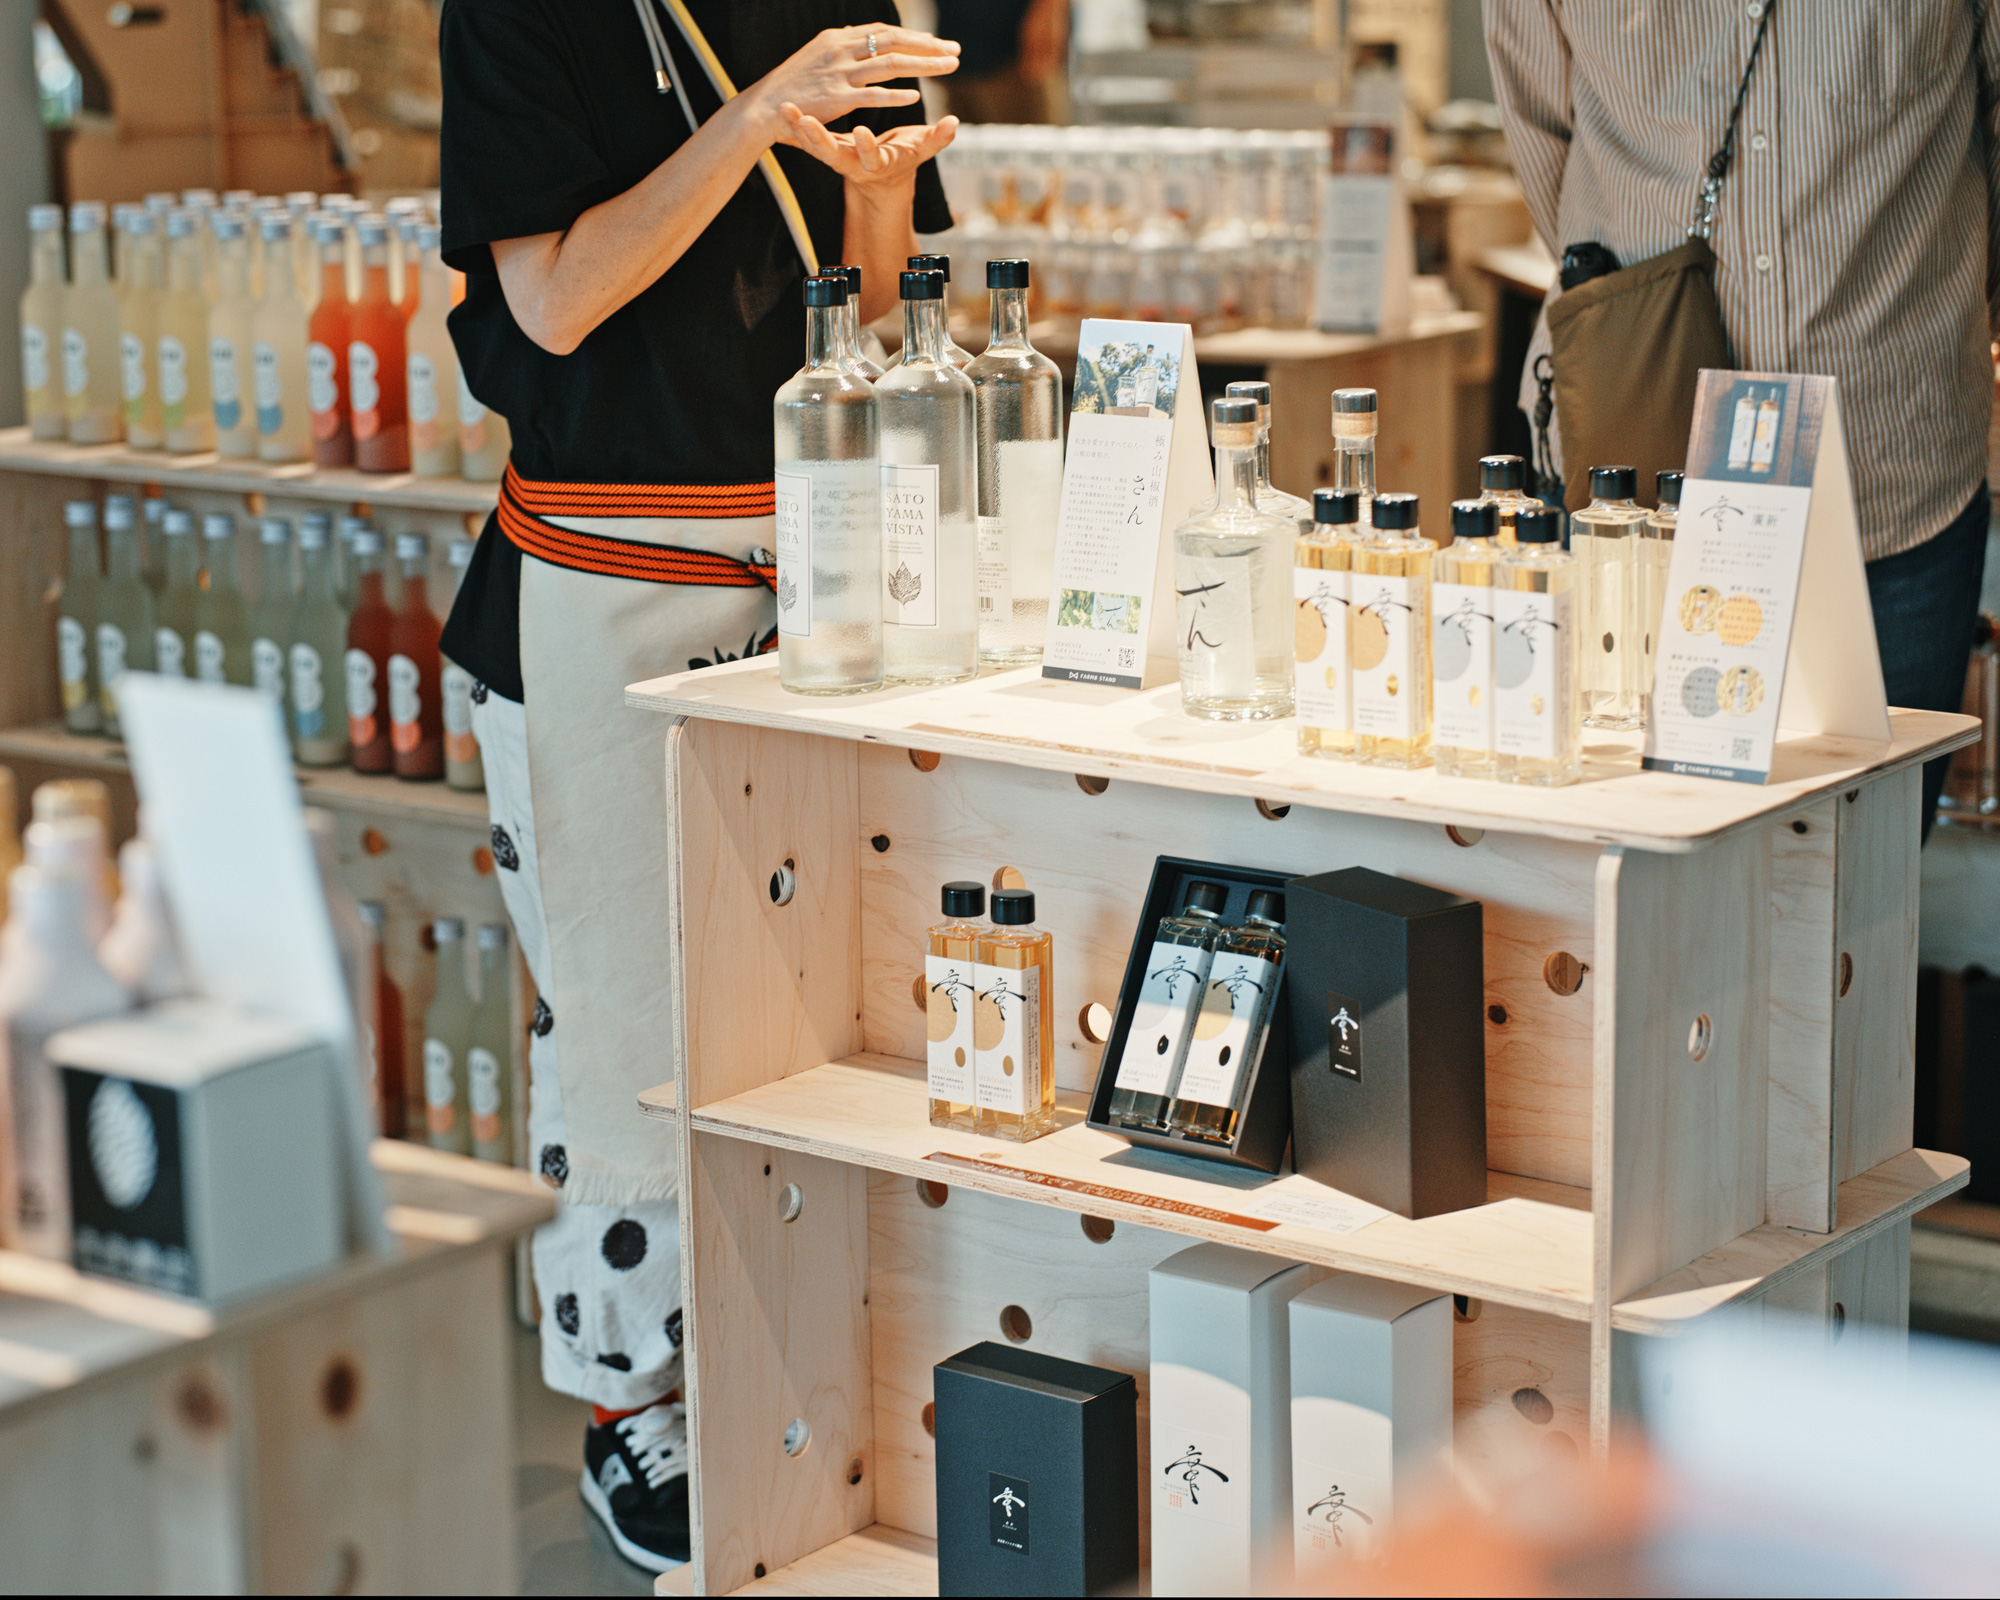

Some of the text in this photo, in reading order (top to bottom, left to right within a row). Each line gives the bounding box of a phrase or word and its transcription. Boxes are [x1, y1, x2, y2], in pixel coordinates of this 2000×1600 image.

[885, 492, 924, 504] SATO
[1127, 474, 1145, 526] さん
[776, 499, 798, 513] ATO
[886, 507, 923, 519] YAMA
[776, 515, 798, 528] AMA
[886, 523, 923, 535] VISTA
[1080, 673, 1117, 683] FARMS STAND
